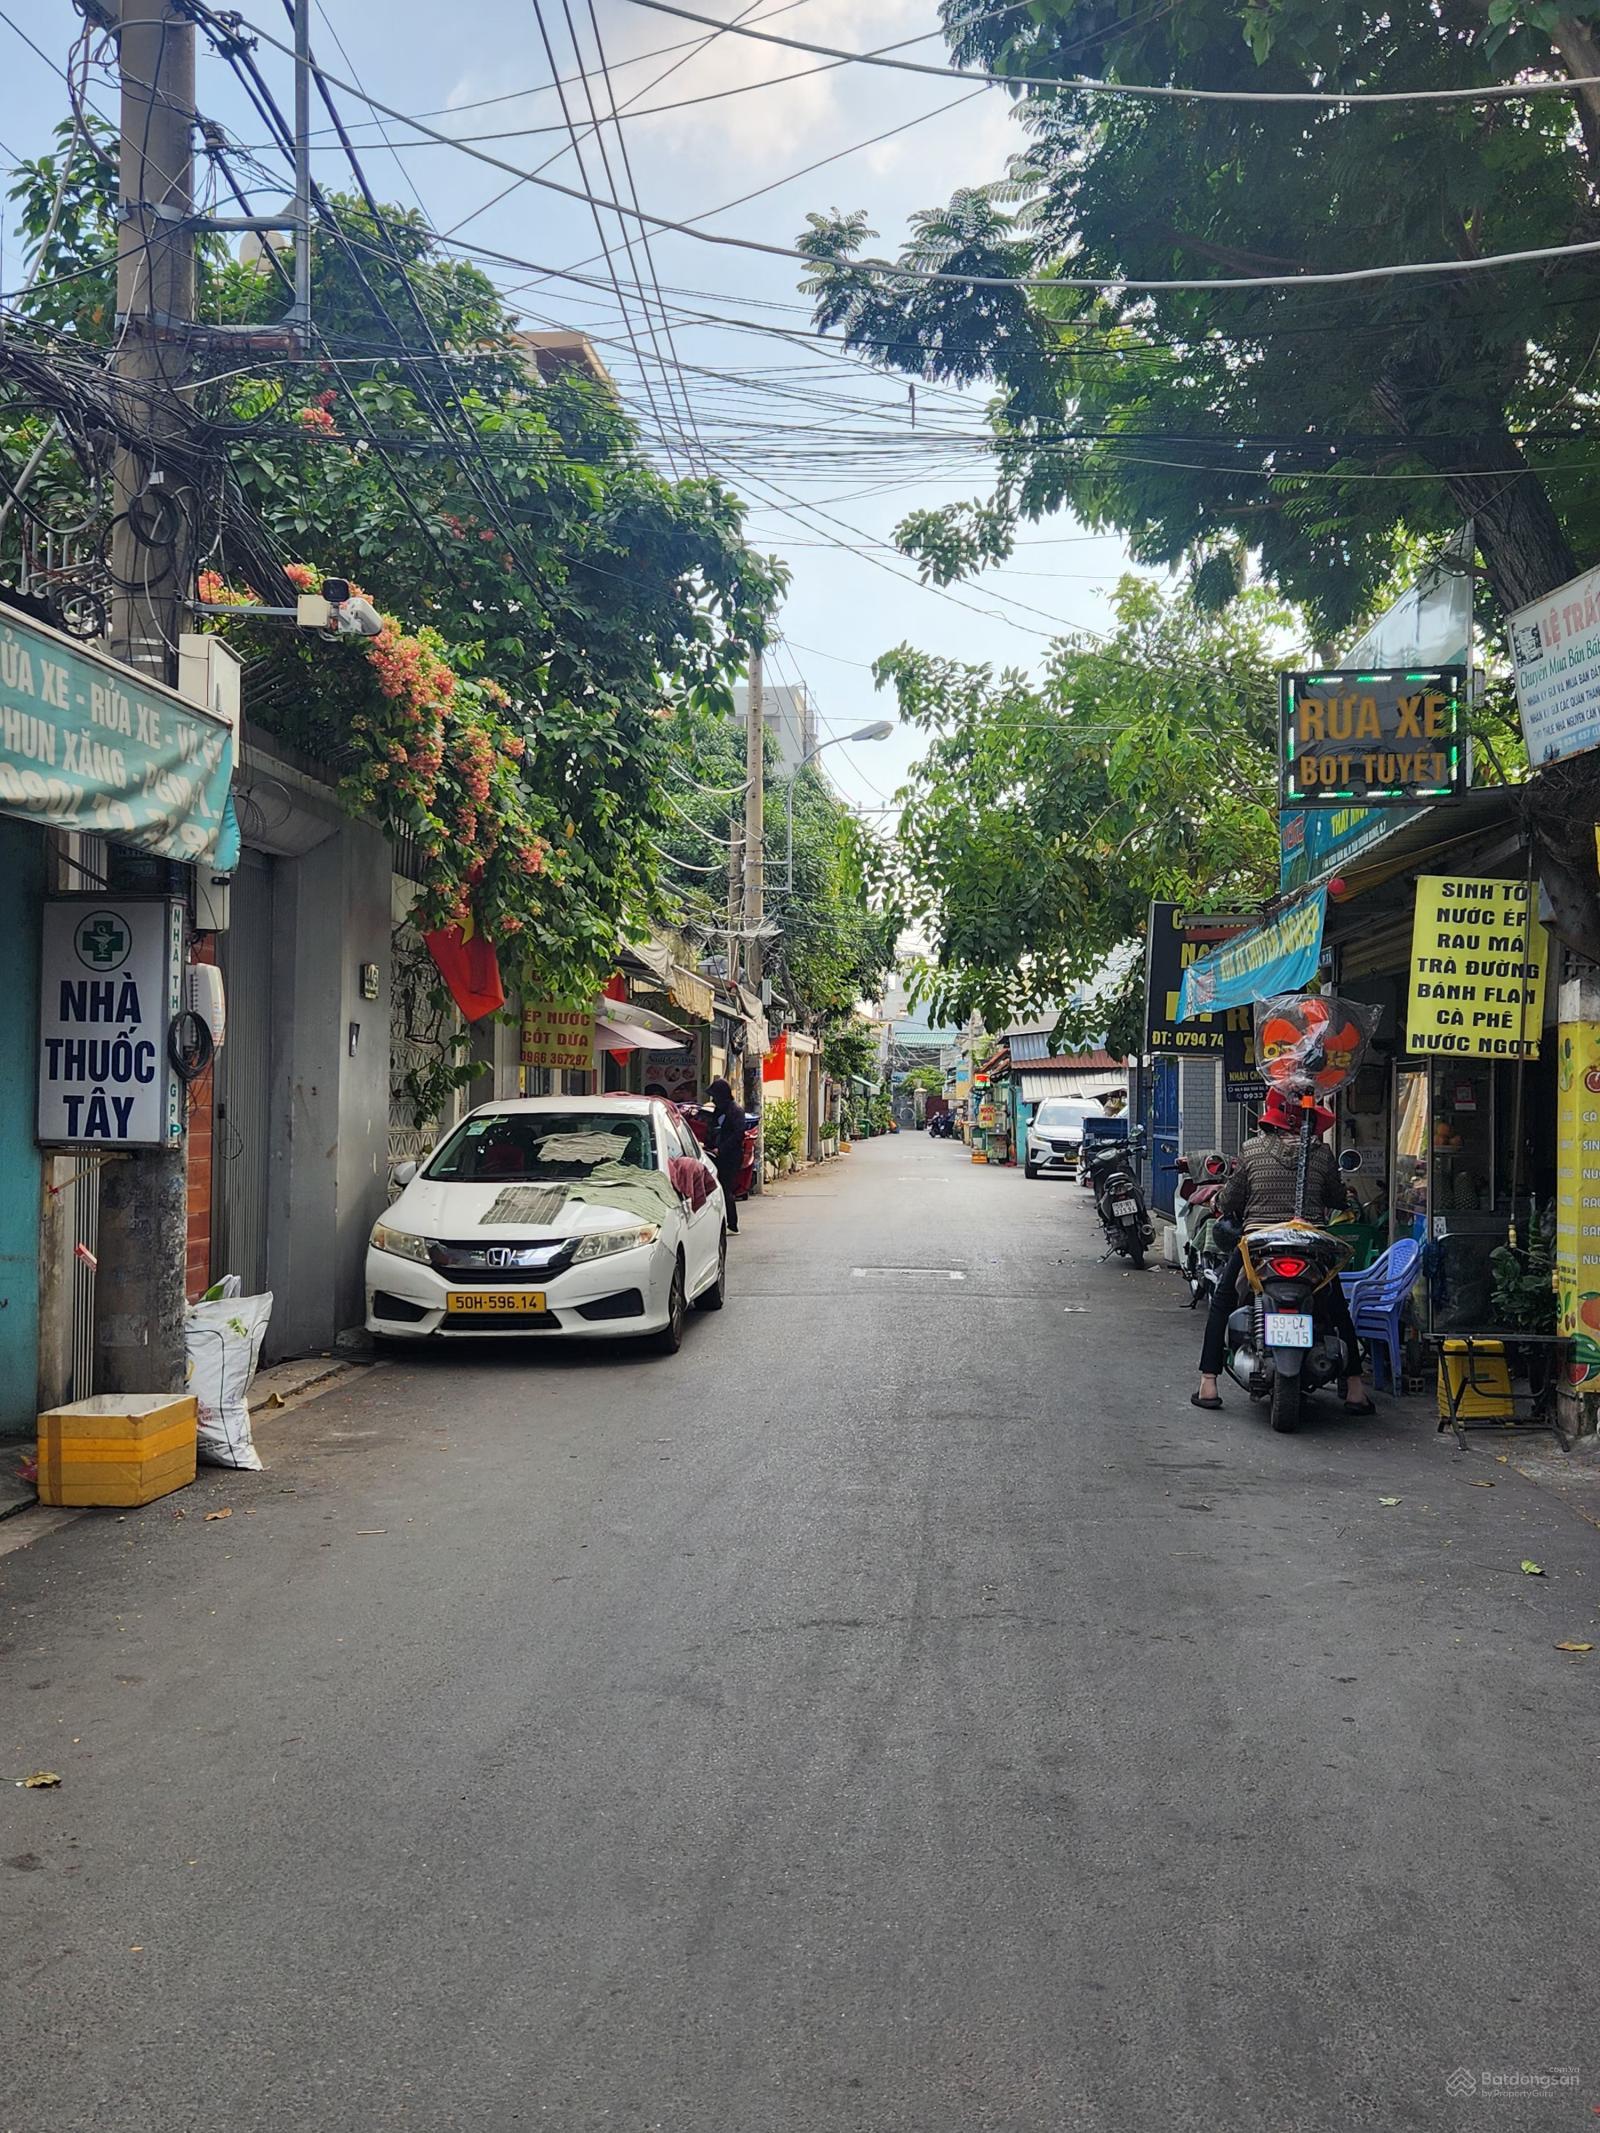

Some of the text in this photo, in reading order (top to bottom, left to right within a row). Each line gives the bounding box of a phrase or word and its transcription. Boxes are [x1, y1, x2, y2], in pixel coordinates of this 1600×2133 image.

[0, 627, 36, 697] ỬA
[40, 658, 70, 711] XE
[90, 676, 132, 737] RỬA
[136, 703, 161, 749] XE
[1395, 693, 1451, 739] XE
[0, 705, 56, 766] HUN
[63, 727, 127, 790] XĂNG
[1442, 881, 1528, 901] SINH TỐ
[1437, 907, 1527, 927] NƯỚC ÉP
[1437, 933, 1524, 953] RAU MÁ
[1417, 956, 1539, 979] TRÀ ĐƯỜNG
[59, 972, 142, 1023] NHÀ
[1417, 982, 1536, 1004] BÁNH FLAN
[547, 1009, 591, 1027] NƯỚC
[1436, 1008, 1513, 1029] CÀ PHÊ
[522, 1029, 552, 1046] CỐT
[1152, 1030, 1172, 1046] ĐT:
[1175, 1031, 1207, 1047] 0794
[1412, 1032, 1535, 1058] NƯỚC NGỌT
[45, 1026, 156, 1084] THUỐC
[63, 1086, 135, 1138] TÂY
[456, 1296, 537, 1310] 50H-596.14
